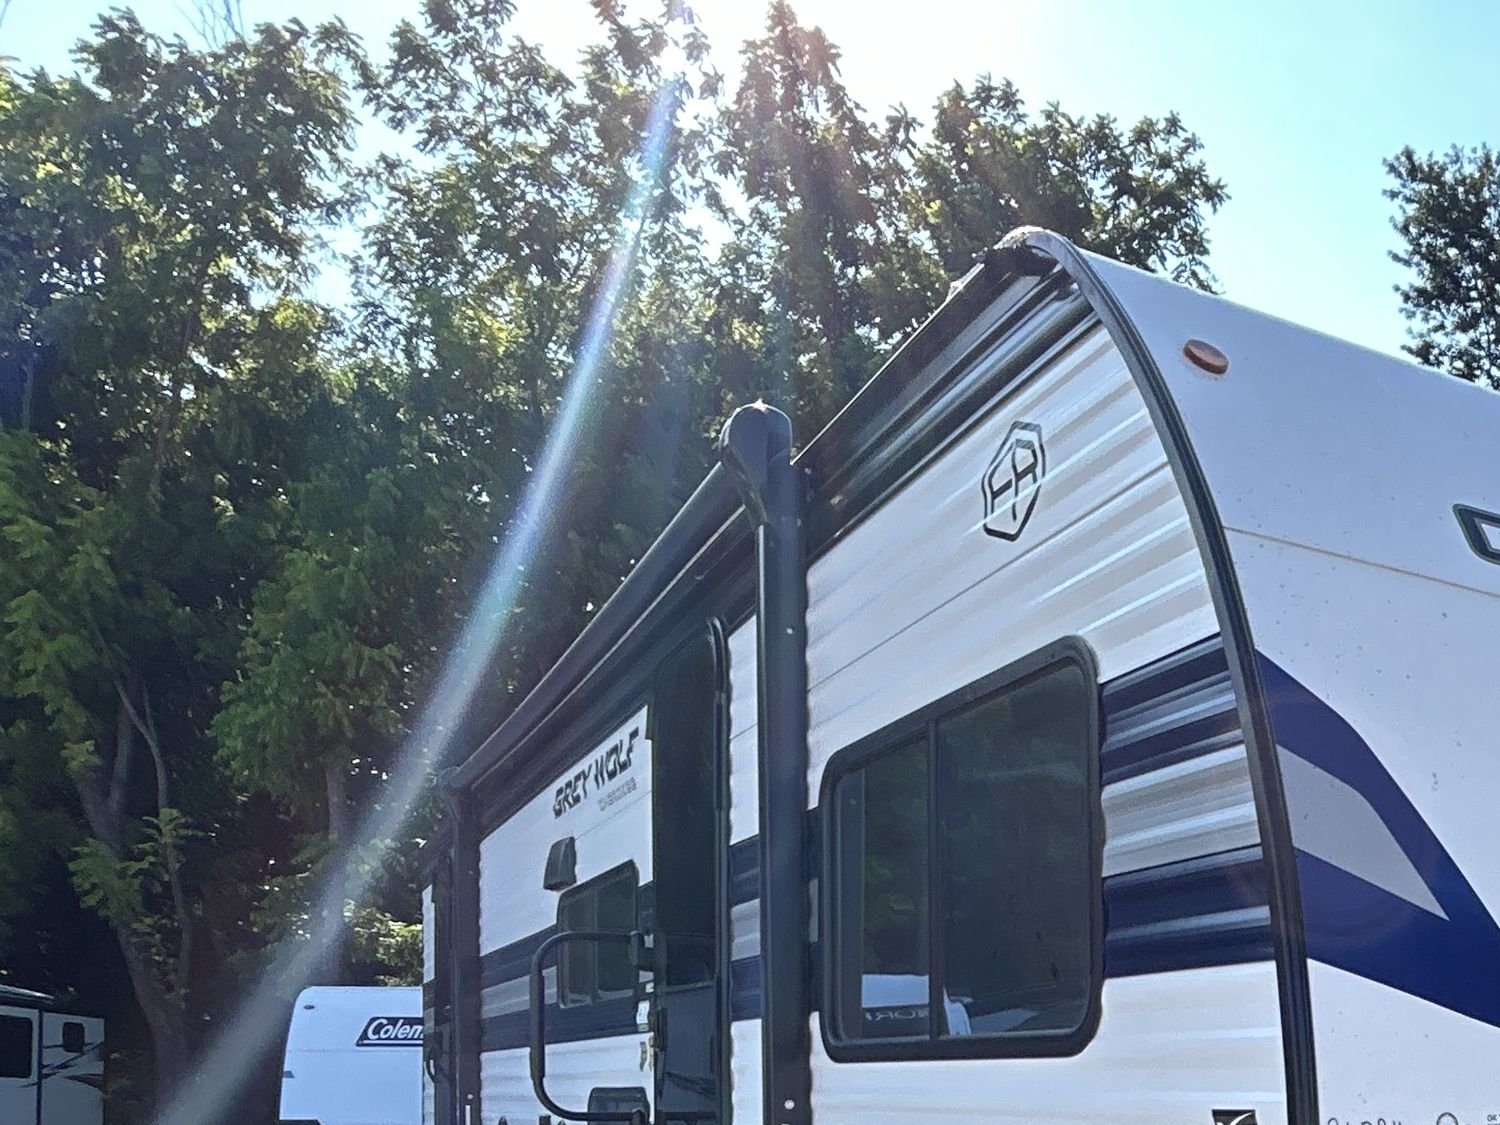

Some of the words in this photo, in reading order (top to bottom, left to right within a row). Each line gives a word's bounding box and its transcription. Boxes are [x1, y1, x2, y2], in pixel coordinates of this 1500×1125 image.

[553, 763, 592, 819] GREY
[594, 726, 639, 790] WOLF
[367, 1018, 424, 1040] Colem
